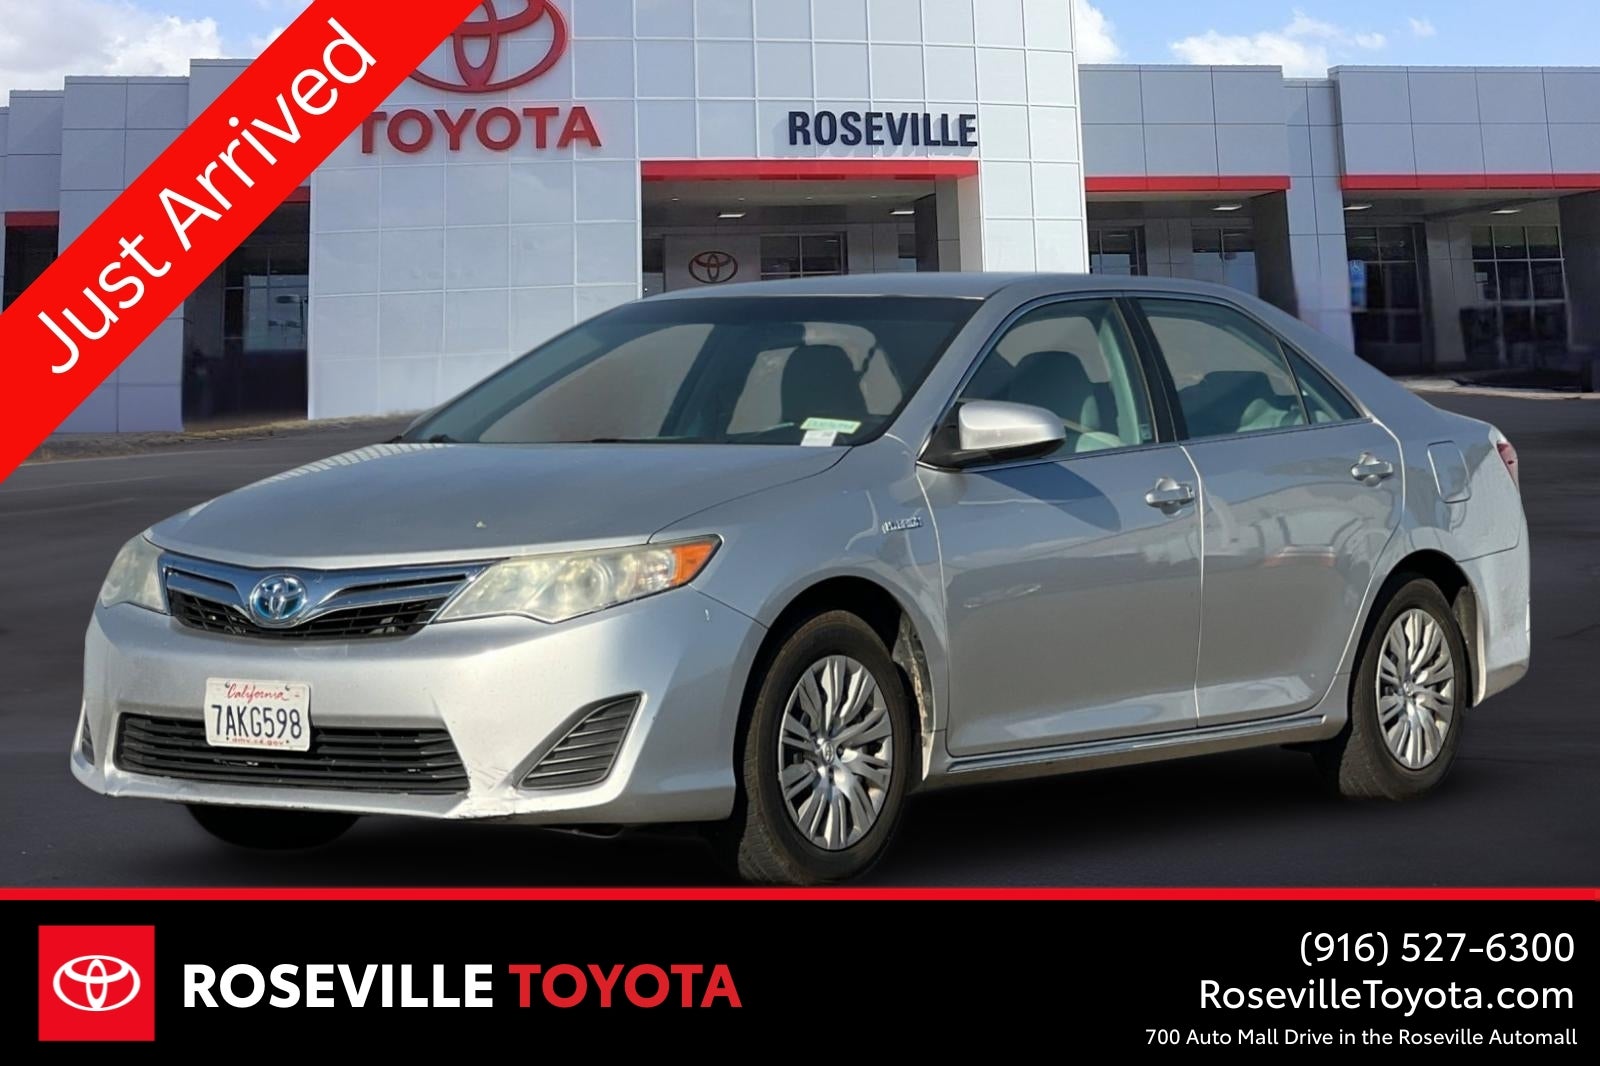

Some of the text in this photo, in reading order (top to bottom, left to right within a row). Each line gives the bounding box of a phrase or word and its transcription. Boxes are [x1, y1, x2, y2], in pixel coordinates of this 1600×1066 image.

[361, 106, 602, 154] TOYOTA
[788, 110, 978, 147] ROSEVILLE
[226, 683, 289, 704] California
[211, 704, 302, 739] 7AKG598
